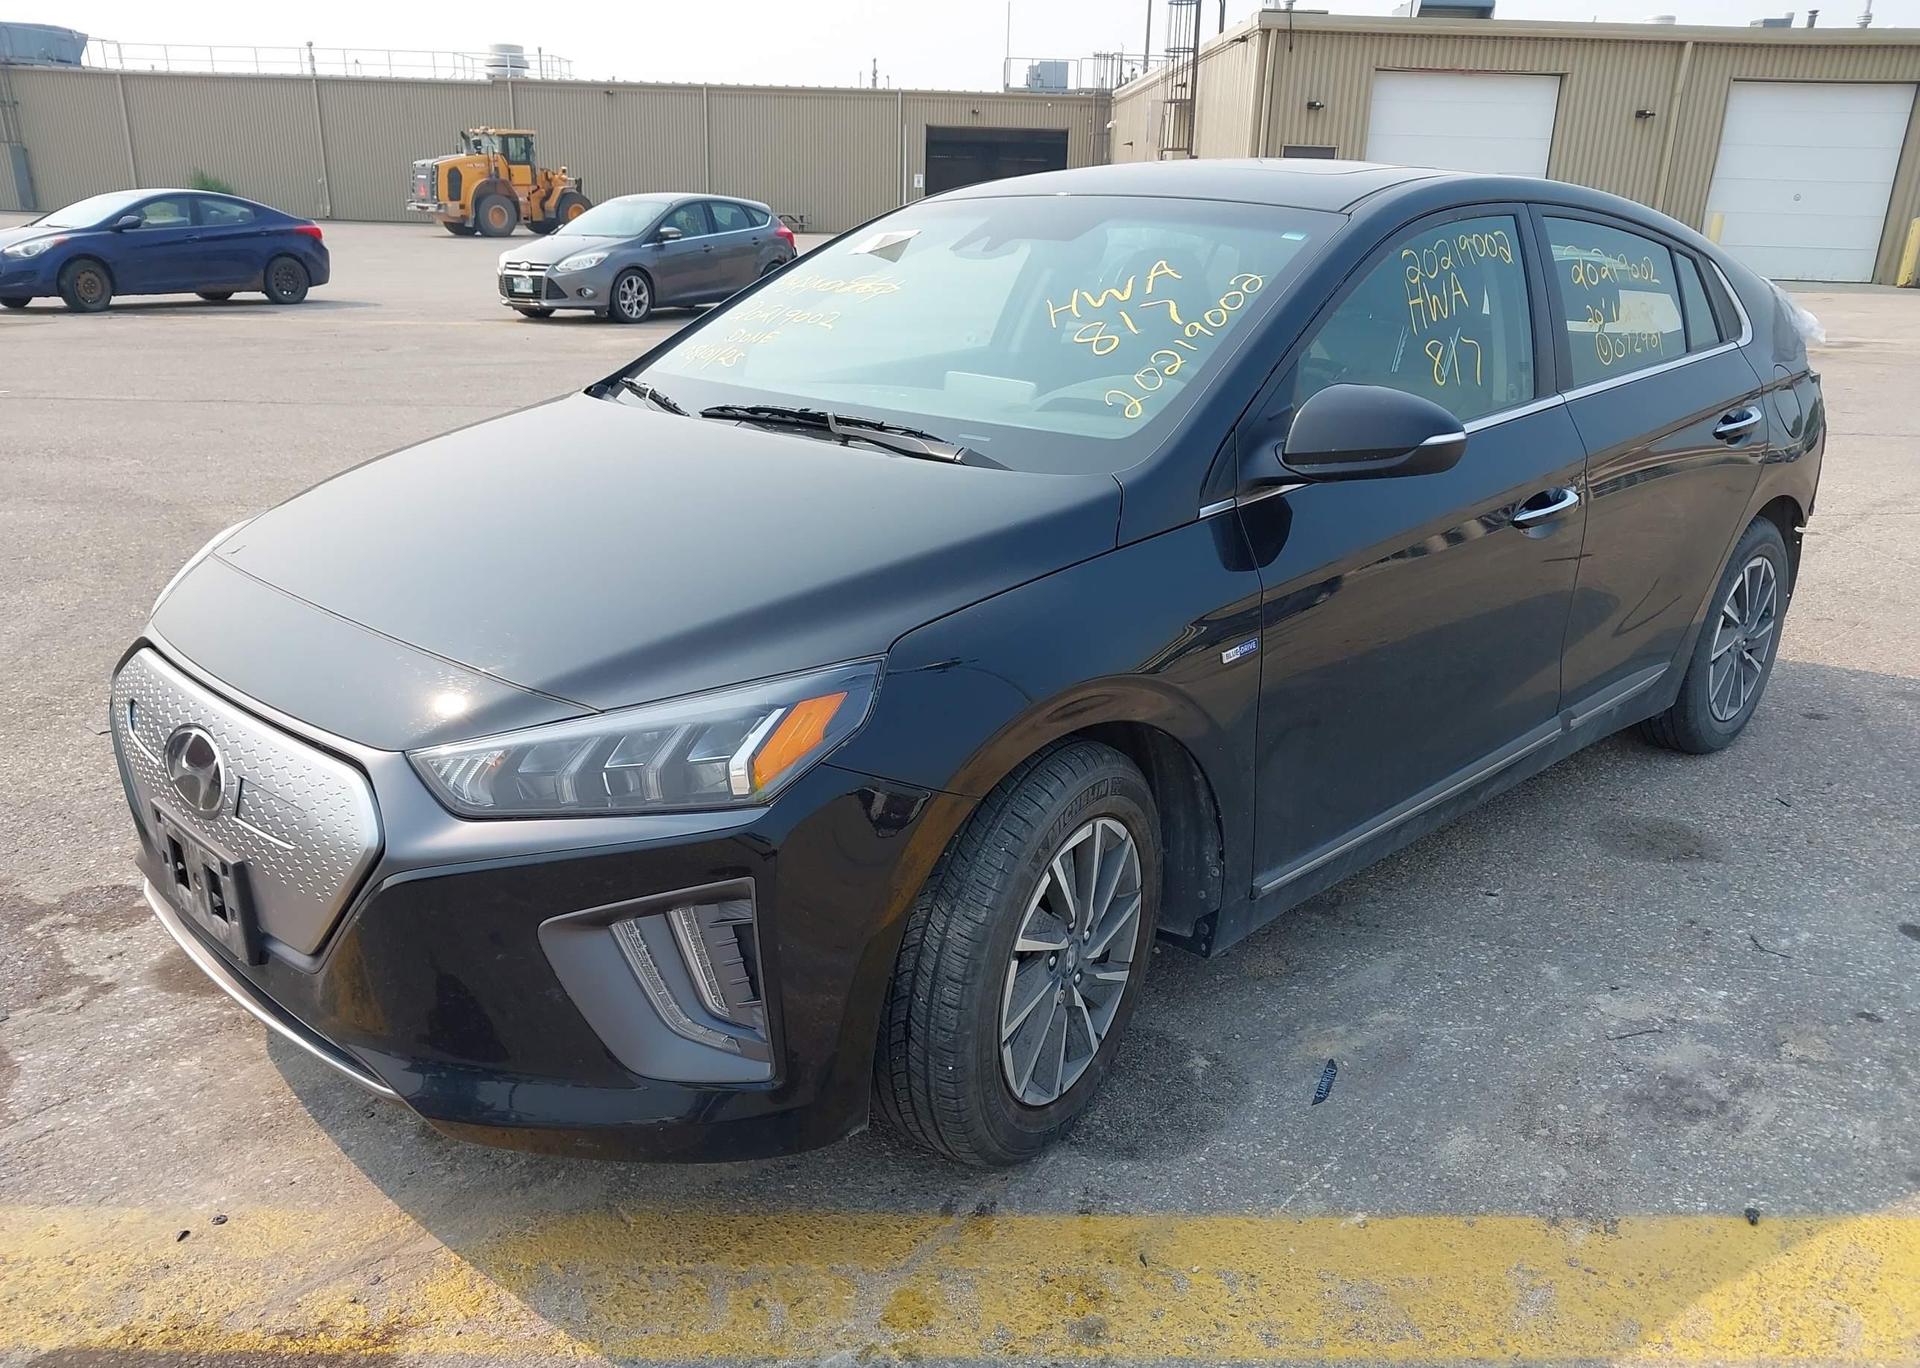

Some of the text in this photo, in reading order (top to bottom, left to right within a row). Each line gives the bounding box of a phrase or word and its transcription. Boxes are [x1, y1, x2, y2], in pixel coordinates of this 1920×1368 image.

[1401, 231, 1515, 284] 20219002
[1563, 245, 1662, 291] 20219002
[1046, 260, 1184, 329] HWA
[1404, 271, 1469, 336] HWA
[1073, 299, 1184, 356] 817
[1104, 273, 1268, 419] 20219002
[1424, 335, 1482, 387] 817
